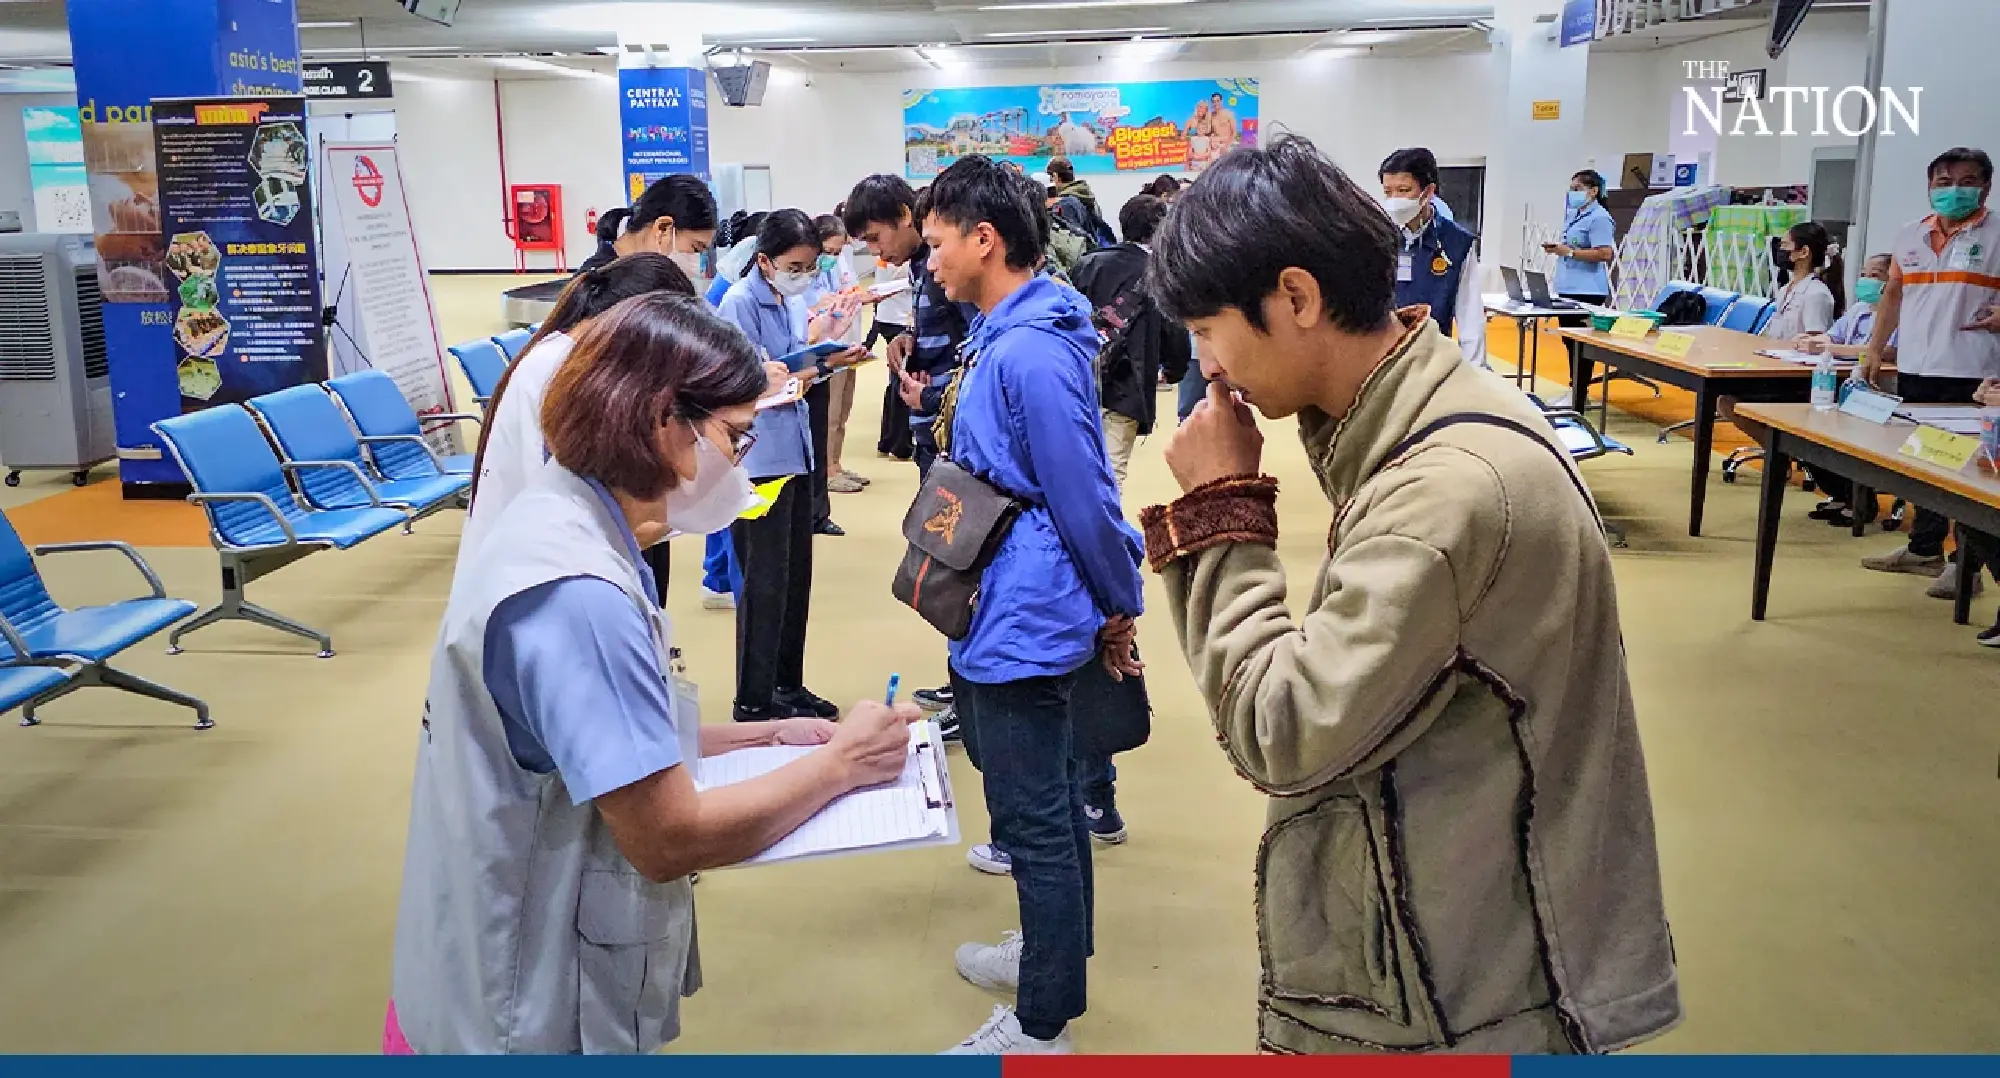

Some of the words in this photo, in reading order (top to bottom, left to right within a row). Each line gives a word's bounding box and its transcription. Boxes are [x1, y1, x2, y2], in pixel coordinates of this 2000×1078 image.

[230, 48, 267, 71] asia's
[270, 52, 298, 75] best
[357, 69, 374, 93] 2
[627, 87, 682, 98] CENTRAL
[630, 98, 679, 108] PATTAYA
[1115, 122, 1176, 143] Biggest
[1117, 138, 1160, 158] Best
